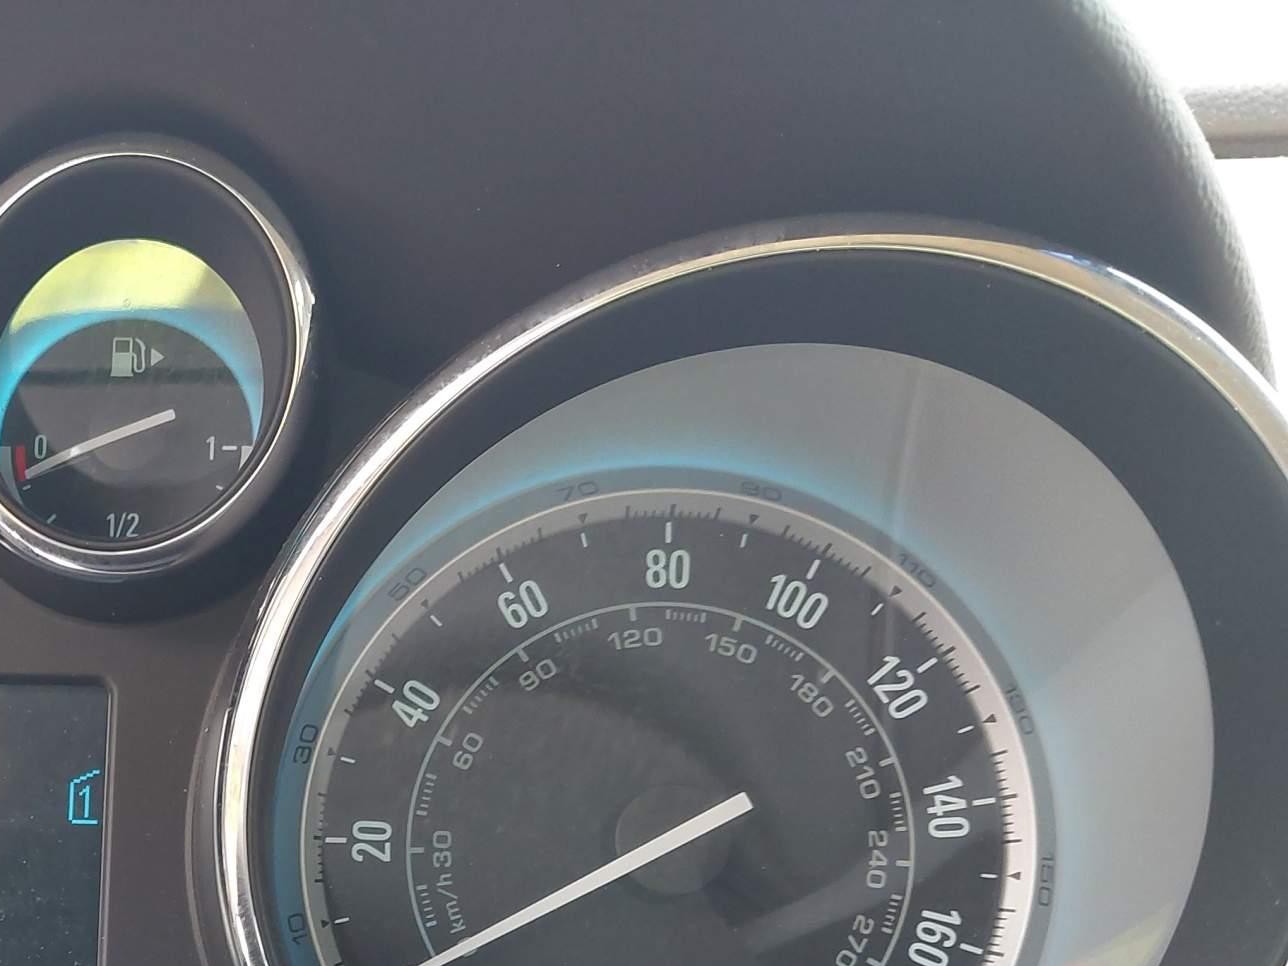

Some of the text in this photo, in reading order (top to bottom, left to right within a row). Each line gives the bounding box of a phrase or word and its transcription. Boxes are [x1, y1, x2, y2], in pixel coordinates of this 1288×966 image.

[35, 434, 48, 460] 0
[205, 436, 216, 461] 1
[105, 512, 140, 539] 1/2
[387, 567, 428, 602] 50
[645, 548, 692, 590] 80
[497, 579, 550, 629] 60
[765, 573, 829, 630] 100
[608, 627, 664, 651] 120
[704, 632, 758, 665] 150
[518, 658, 558, 693] 90
[789, 673, 835, 719] 180
[866, 655, 929, 720] 120
[391, 679, 441, 729] 40
[293, 724, 319, 764] 30
[451, 732, 485, 771] 60
[845, 746, 882, 800] 210
[922, 775, 971, 839] 140
[350, 819, 393, 864] 20
[432, 830, 452, 868] 30
[865, 829, 888, 889] 240
[435, 873, 467, 934] km/h
[288, 912, 308, 945] 10
